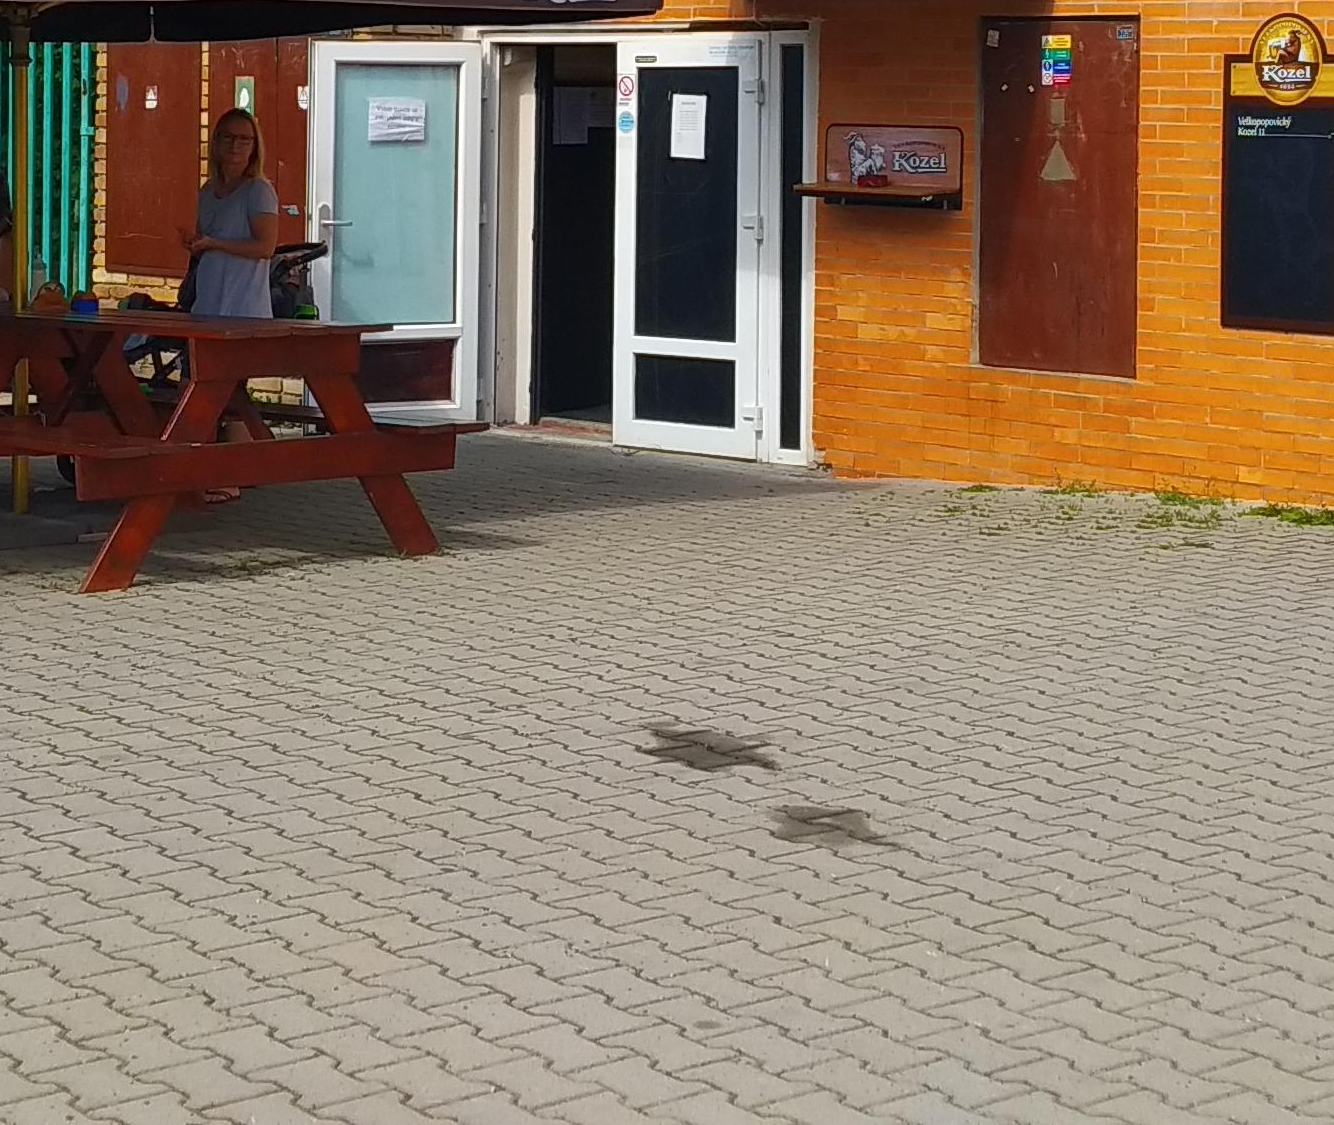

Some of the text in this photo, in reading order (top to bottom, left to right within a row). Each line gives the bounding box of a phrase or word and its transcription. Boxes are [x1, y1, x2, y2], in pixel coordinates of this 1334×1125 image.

[1262, 65, 1312, 83] Kozel
[1237, 116, 1292, 129] Velkopopovický
[1237, 126, 1258, 137] Kozel
[892, 150, 948, 173] Kozel
